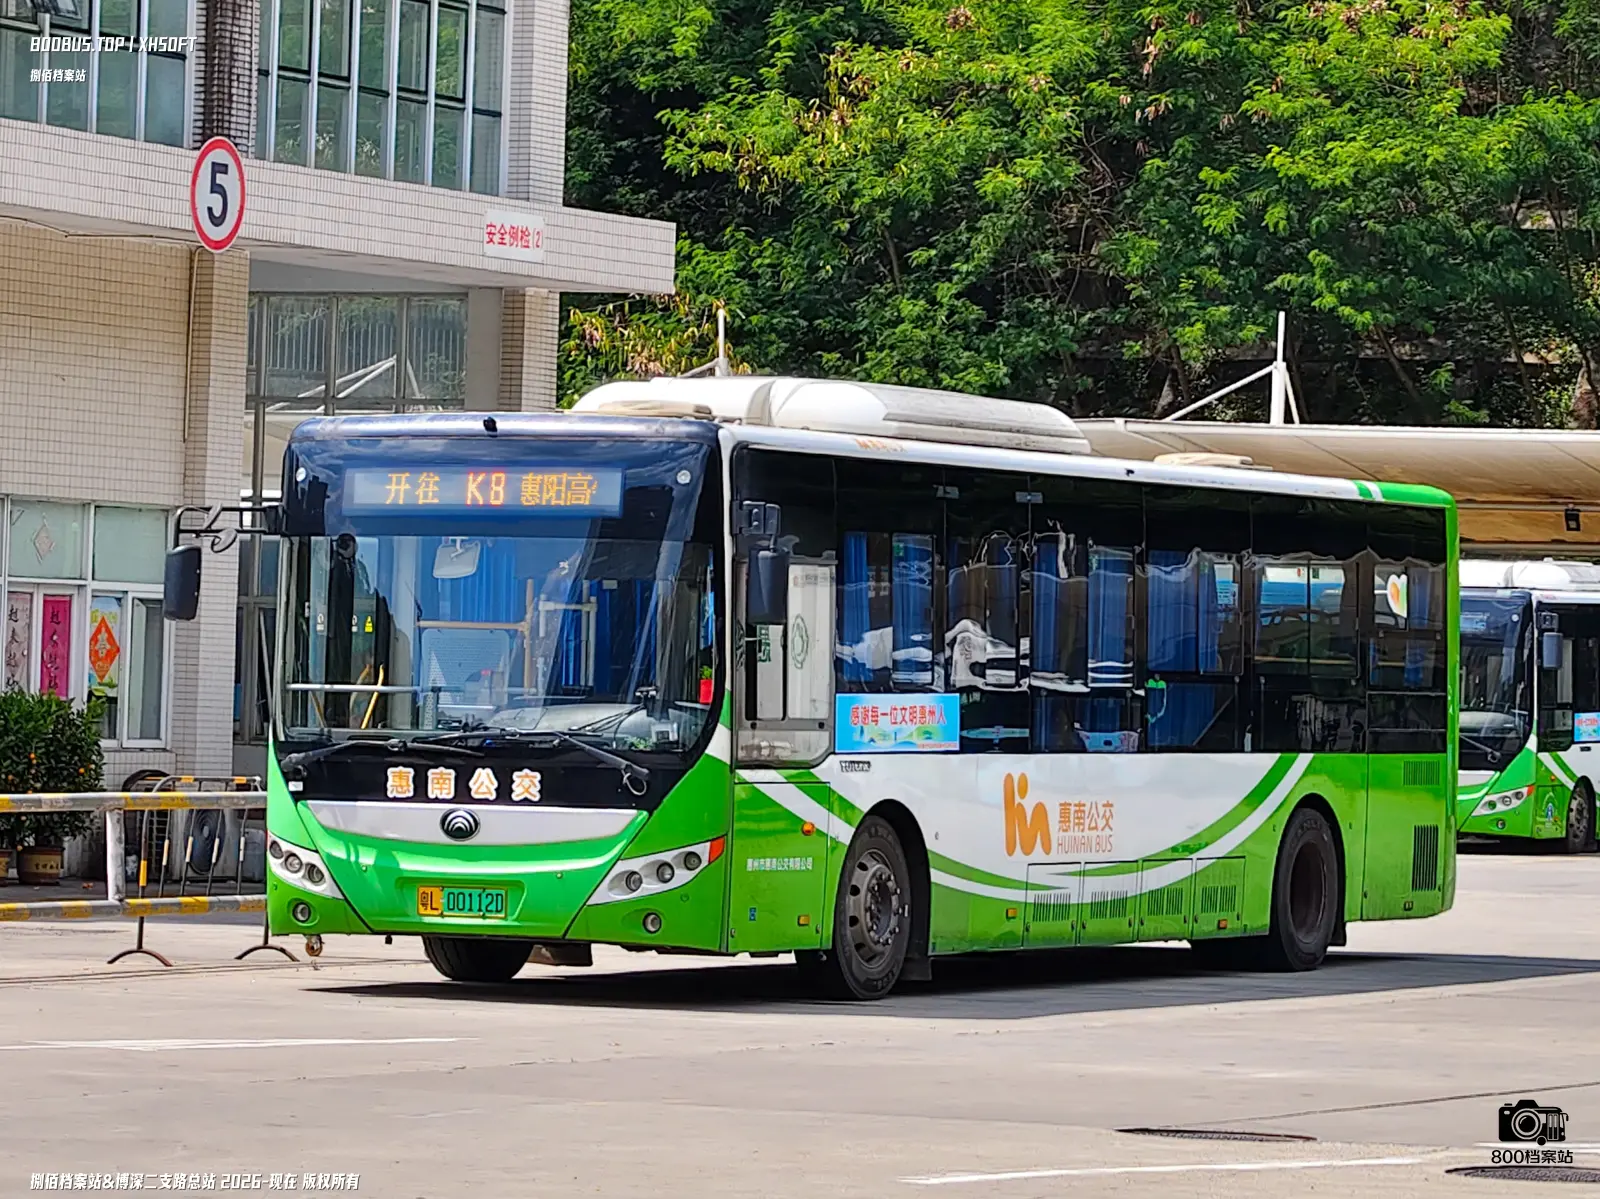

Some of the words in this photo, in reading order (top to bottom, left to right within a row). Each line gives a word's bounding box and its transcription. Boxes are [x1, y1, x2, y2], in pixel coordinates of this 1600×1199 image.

[207, 161, 229, 228] 5
[385, 472, 440, 505] 开往
[465, 472, 506, 506] K8
[850, 704, 946, 726] 感谢每一位文明惠州人
[386, 766, 541, 802] 惠南公交
[1058, 800, 1115, 833] 惠南公交
[1057, 835, 1093, 855] HUINAN
[1095, 834, 1114, 854] BUS
[447, 891, 504, 913] 00112D
